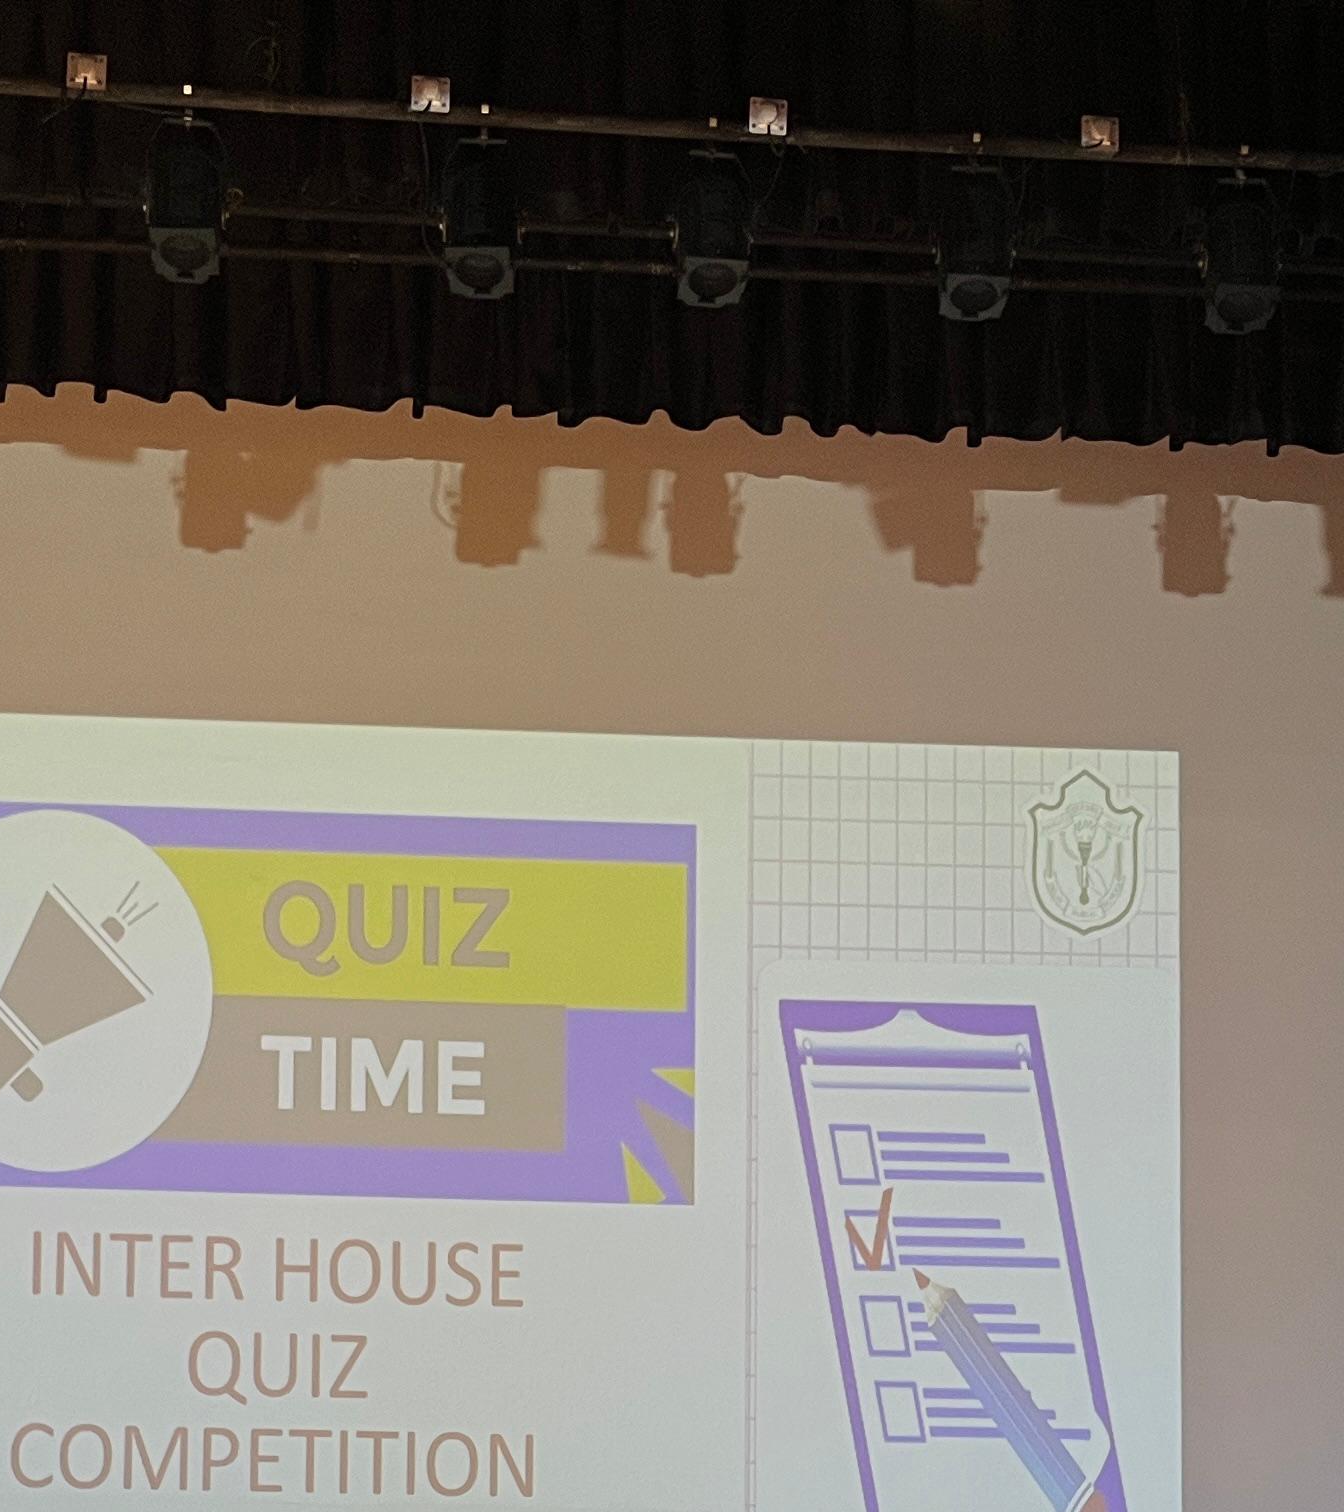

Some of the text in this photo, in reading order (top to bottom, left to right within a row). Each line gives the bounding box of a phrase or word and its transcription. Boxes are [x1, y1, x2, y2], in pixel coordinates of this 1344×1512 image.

[261, 879, 513, 977] QUIZ
[260, 1034, 487, 1116] TIME
[31, 1230, 525, 1308] INTER HOUSE
[188, 1330, 369, 1405] QUIZ
[10, 1422, 536, 1498] COMPETITION
